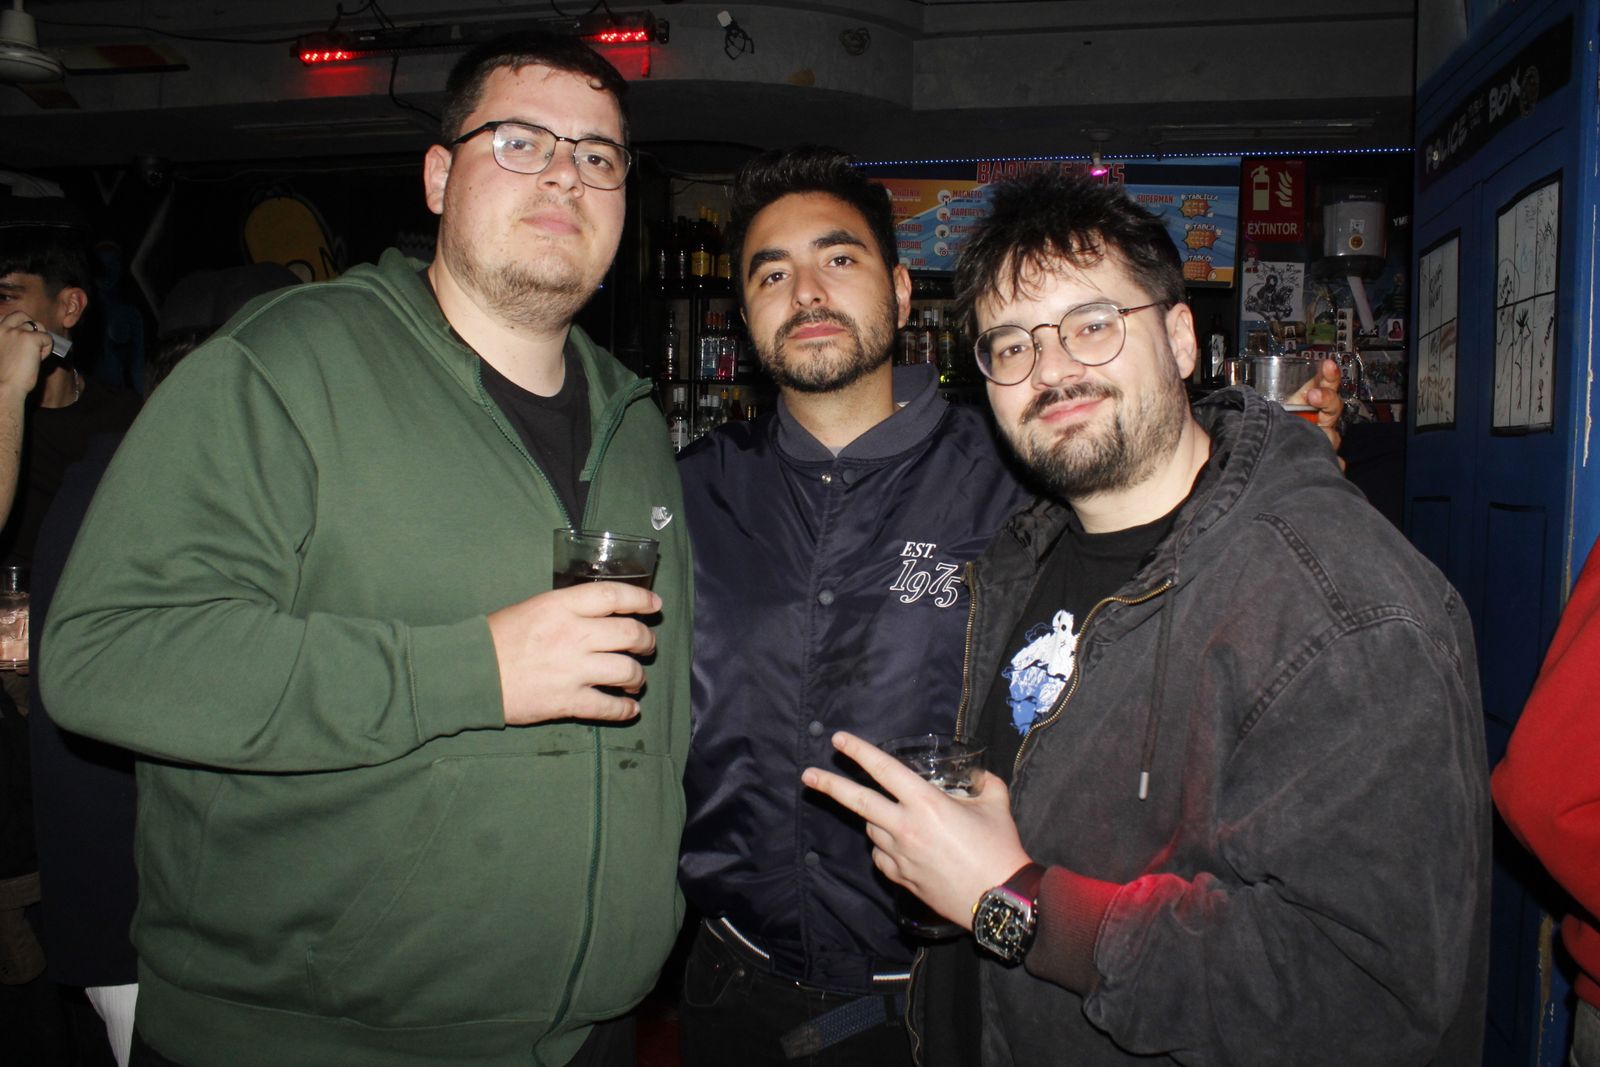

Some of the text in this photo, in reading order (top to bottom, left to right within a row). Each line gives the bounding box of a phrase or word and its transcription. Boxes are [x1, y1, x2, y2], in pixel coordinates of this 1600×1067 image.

[1425, 112, 1468, 176] POLICE
[1488, 64, 1521, 123] BOX
[1137, 194, 1174, 204] SUPERMAN
[1247, 222, 1298, 236] EXTINTOR
[900, 541, 937, 559] EST.
[889, 559, 961, 608] 1975
